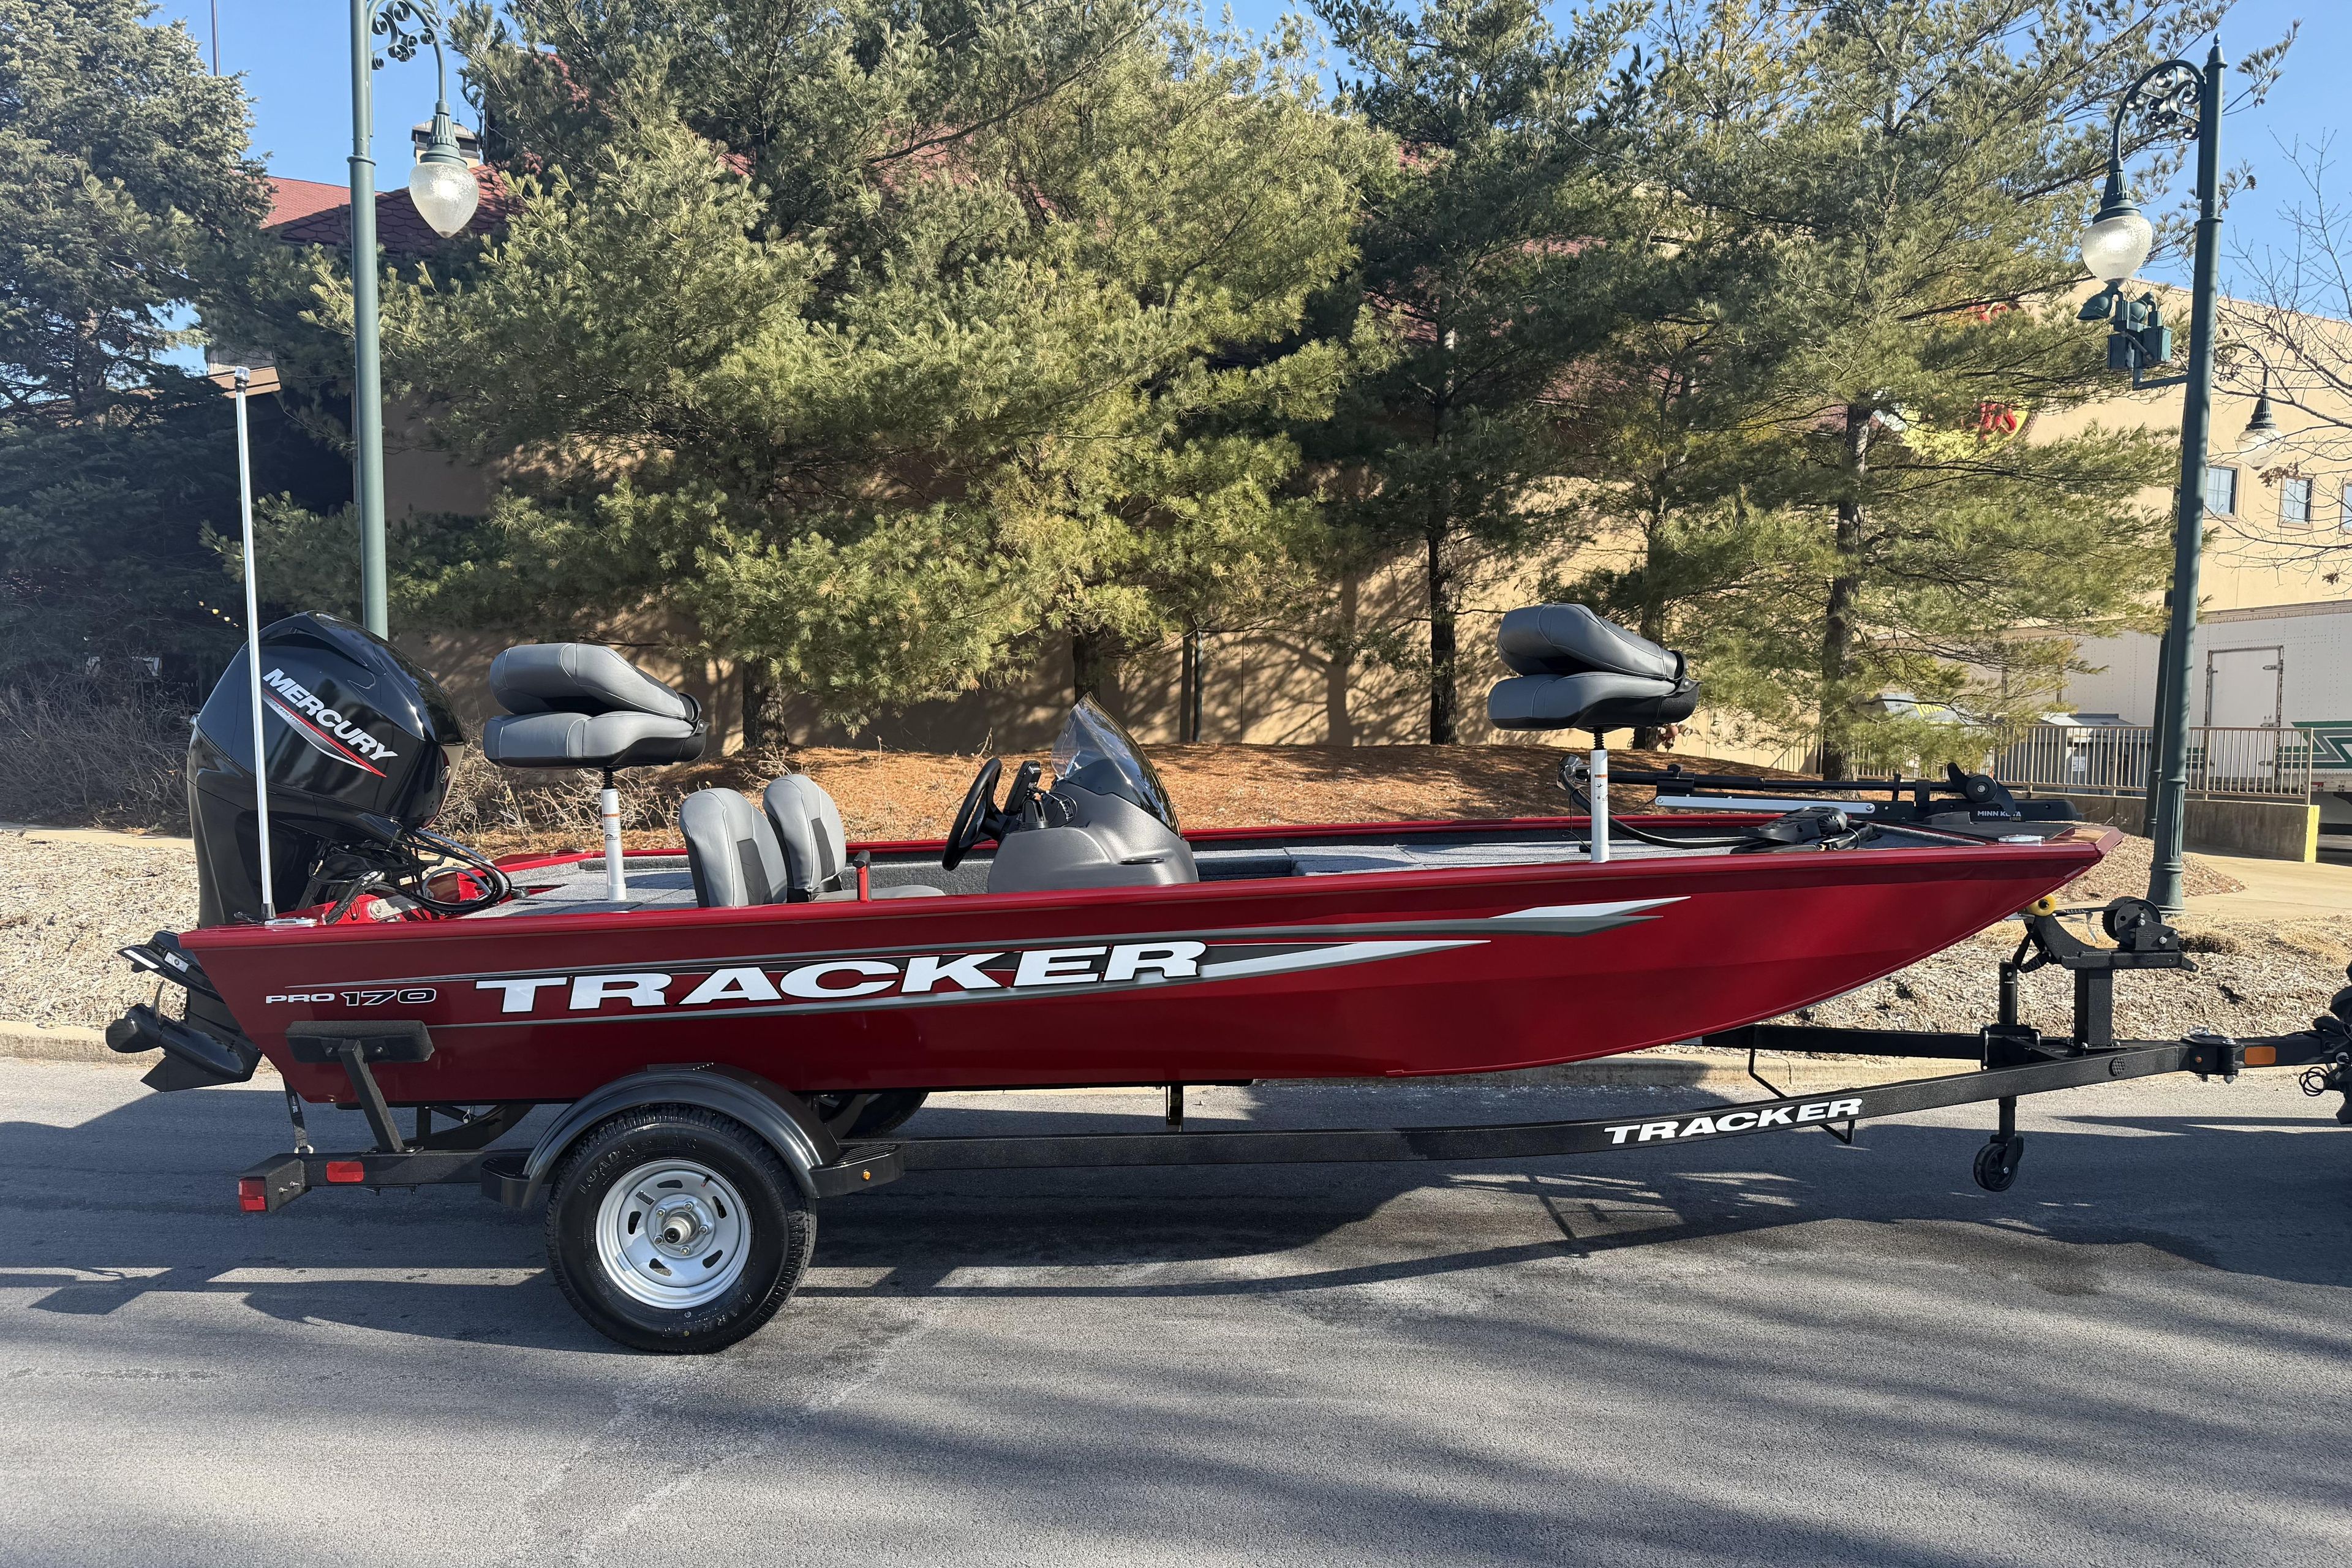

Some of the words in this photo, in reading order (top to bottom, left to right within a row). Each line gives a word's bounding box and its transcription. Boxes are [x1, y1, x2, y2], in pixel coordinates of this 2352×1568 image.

[263, 668, 398, 761] MERCURY
[266, 993, 335, 1004] PRO
[340, 988, 437, 1006] 170
[474, 940, 1209, 1014] TRACKER
[1604, 1098, 1863, 1144] TRACKER
